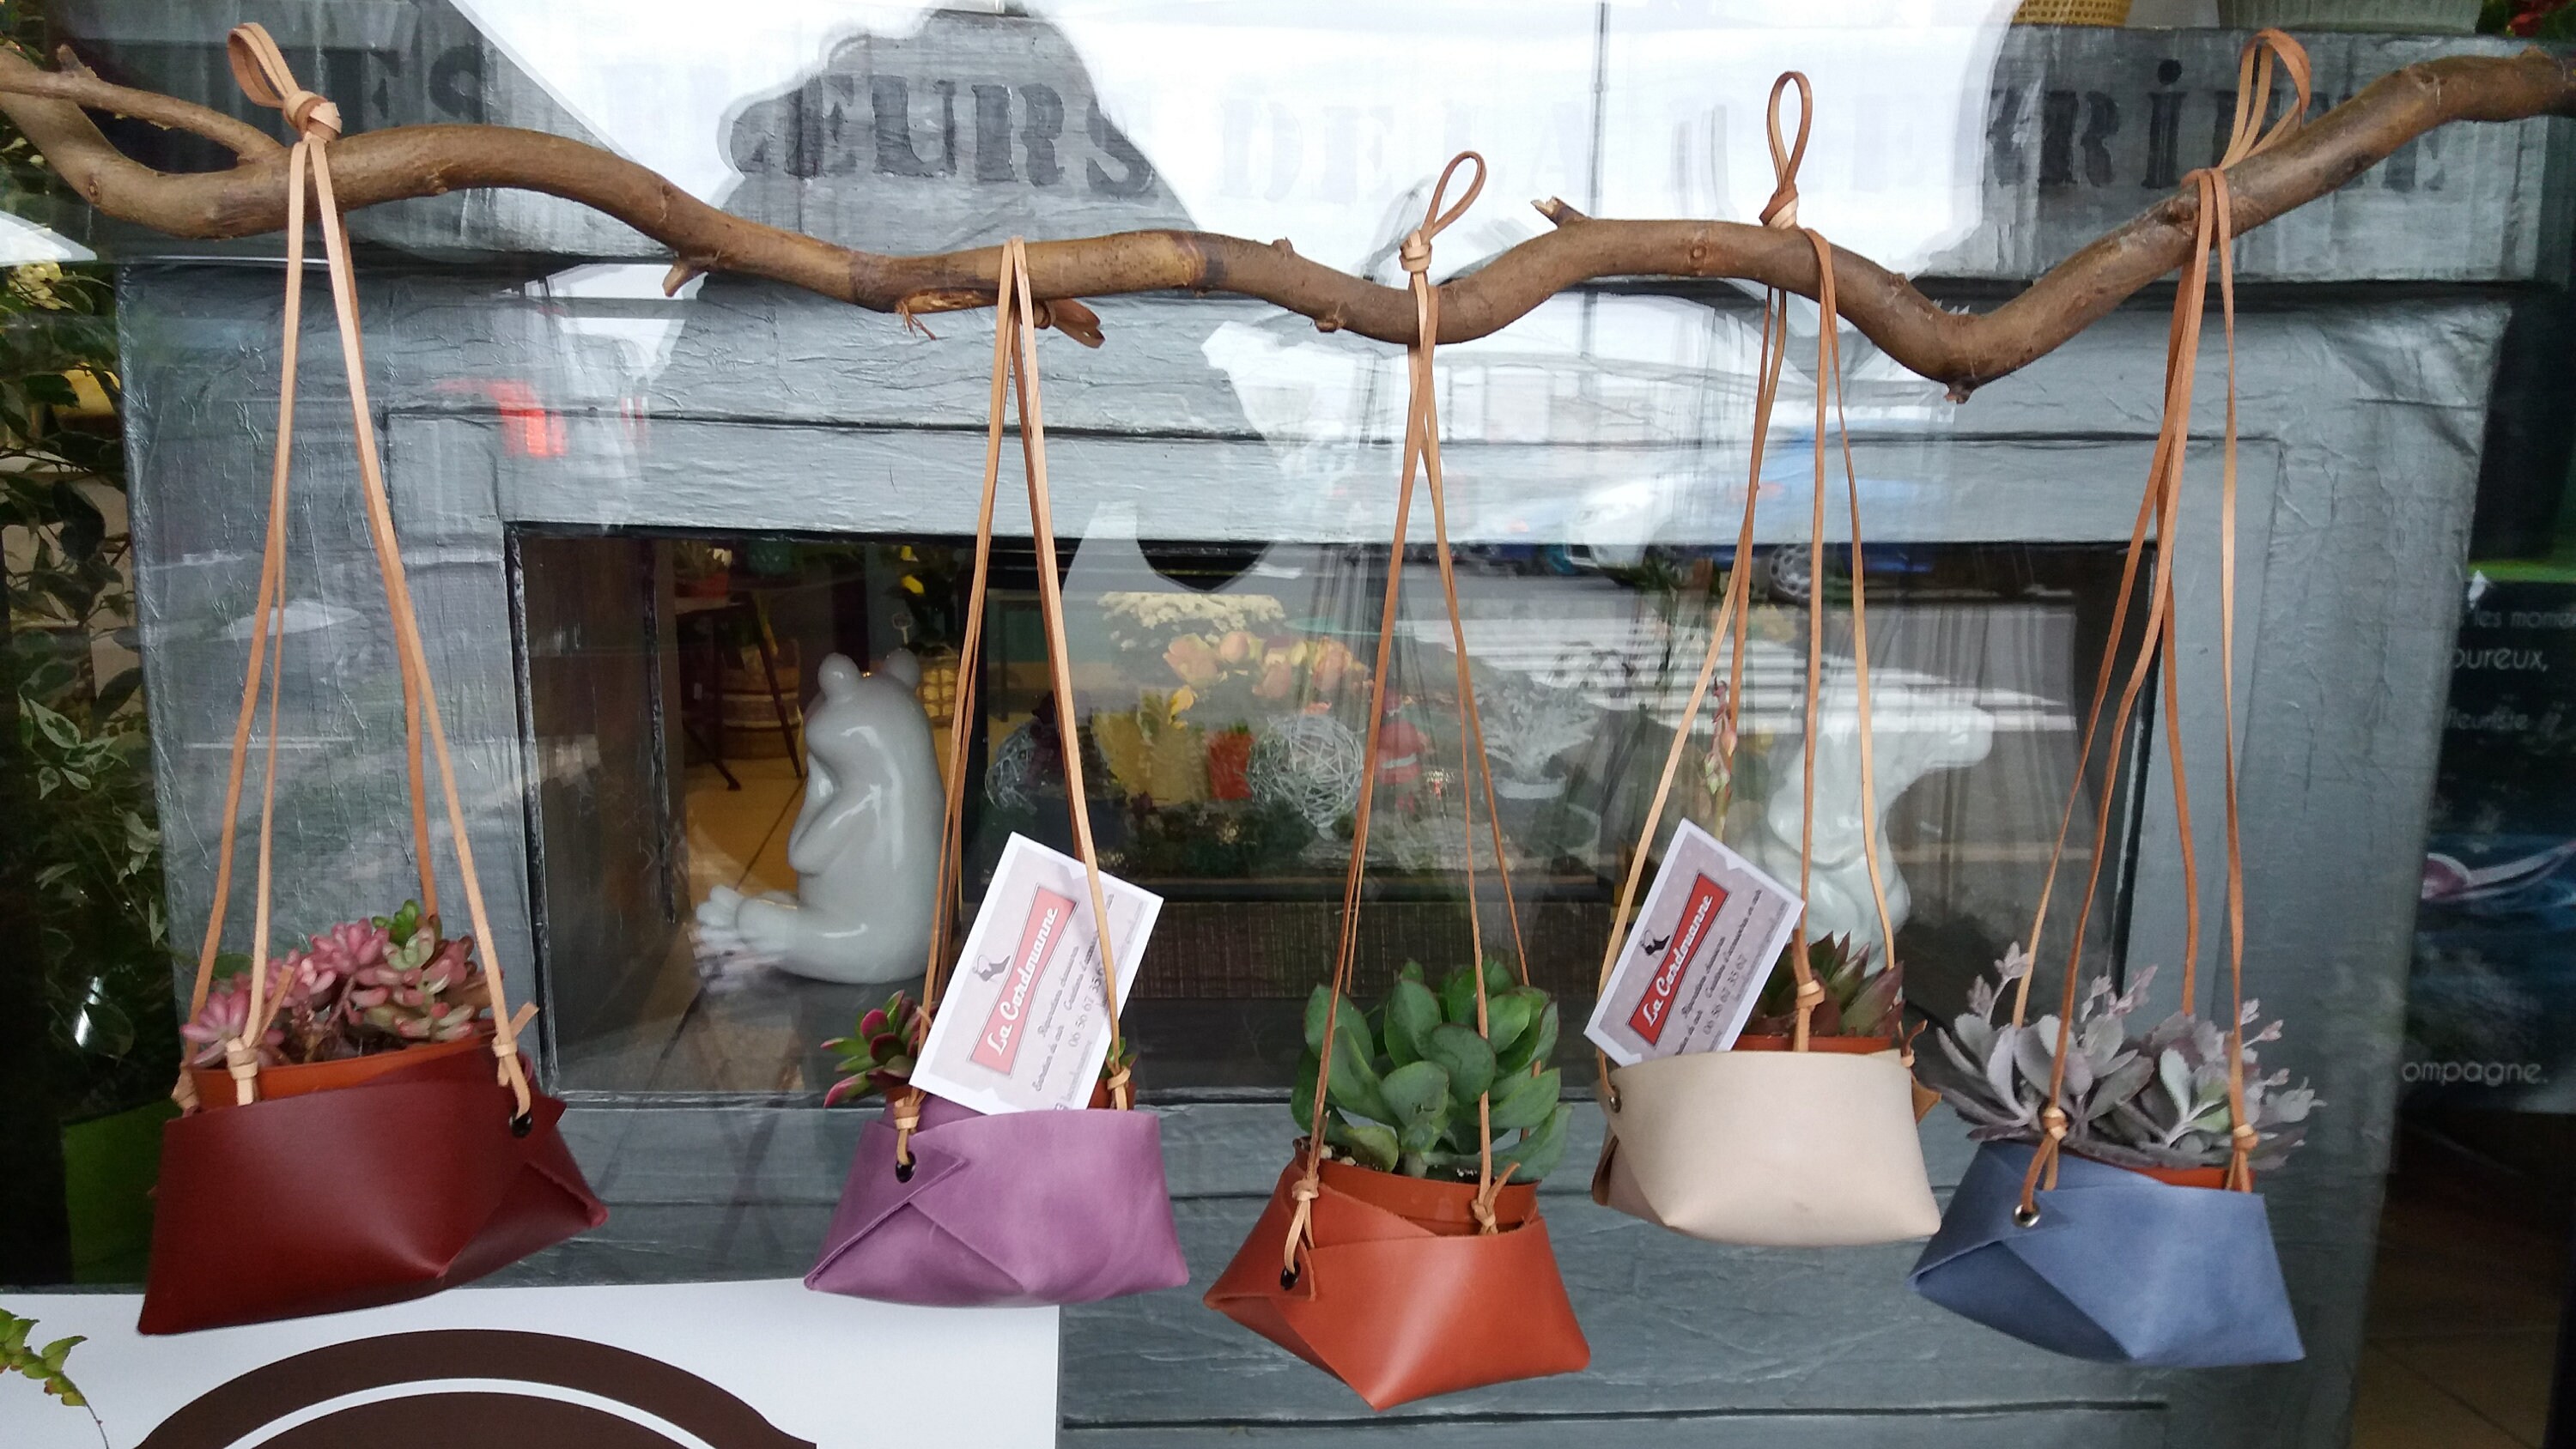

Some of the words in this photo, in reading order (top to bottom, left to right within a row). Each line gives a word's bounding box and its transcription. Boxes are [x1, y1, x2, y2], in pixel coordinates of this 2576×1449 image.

[999, 907, 1057, 1020] Cordouanne
[1642, 1000, 1662, 1027] La
[1656, 895, 1712, 995] Cordouanne
[987, 1025, 1012, 1055] La
[1066, 1031, 1081, 1048] 06
[1081, 995, 1094, 1011] 67
[1088, 977, 1102, 993] 35
